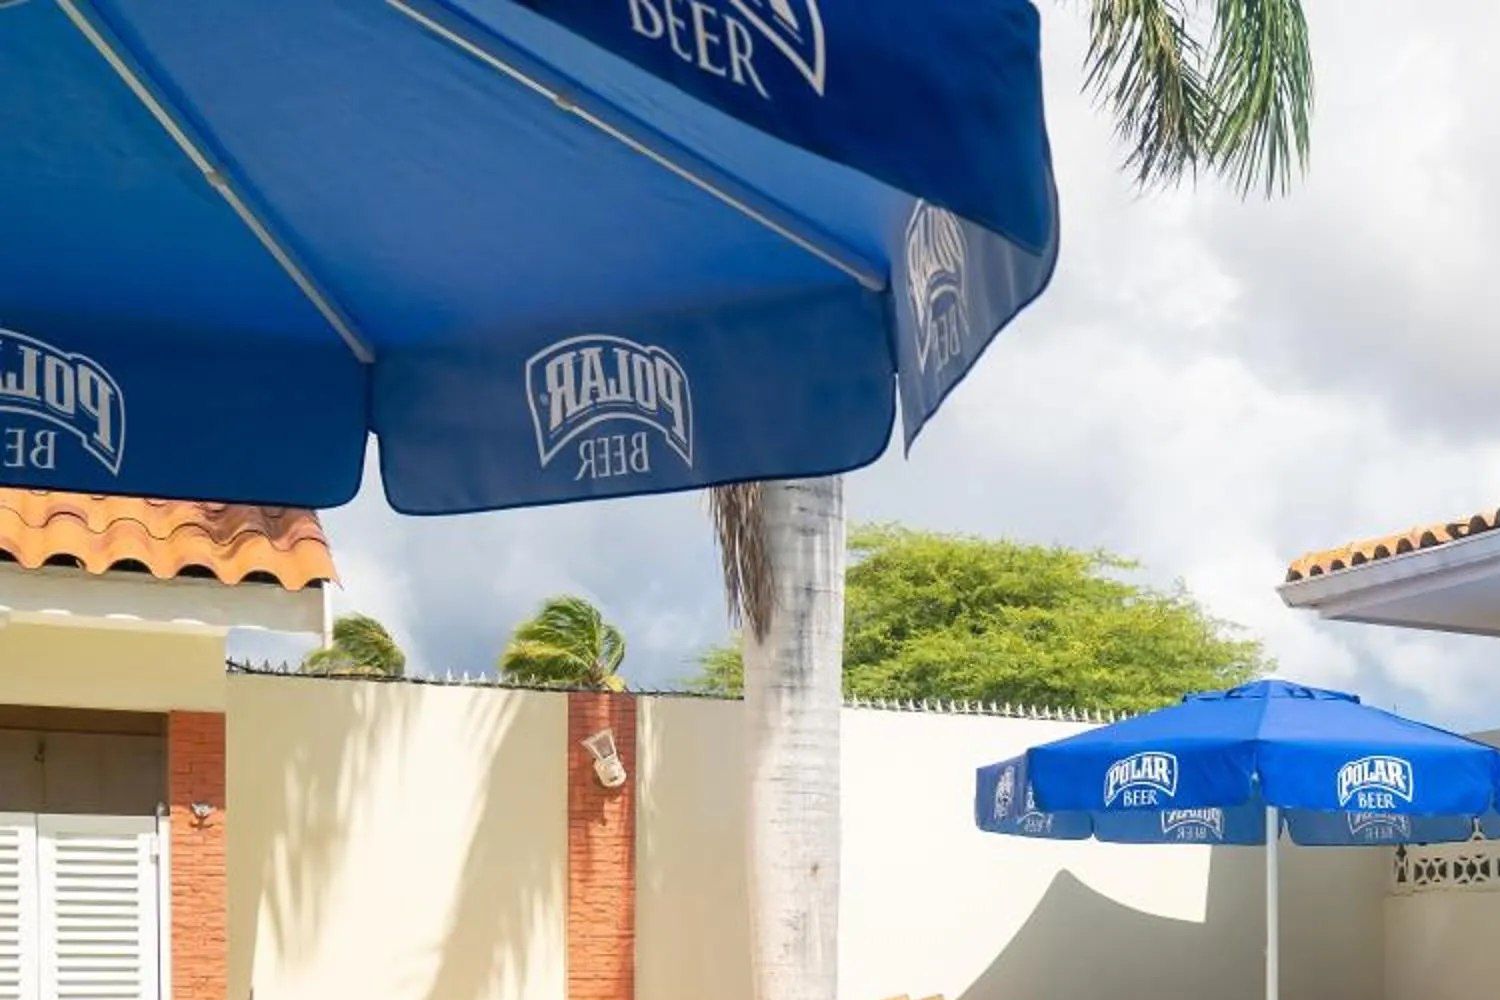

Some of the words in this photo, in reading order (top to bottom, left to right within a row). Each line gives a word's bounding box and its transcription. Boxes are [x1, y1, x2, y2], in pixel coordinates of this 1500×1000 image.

[1107, 756, 1172, 801] POLAR
[1341, 759, 1407, 799] POLAR
[1123, 788, 1159, 807] BEER
[1357, 791, 1396, 809] BEER
